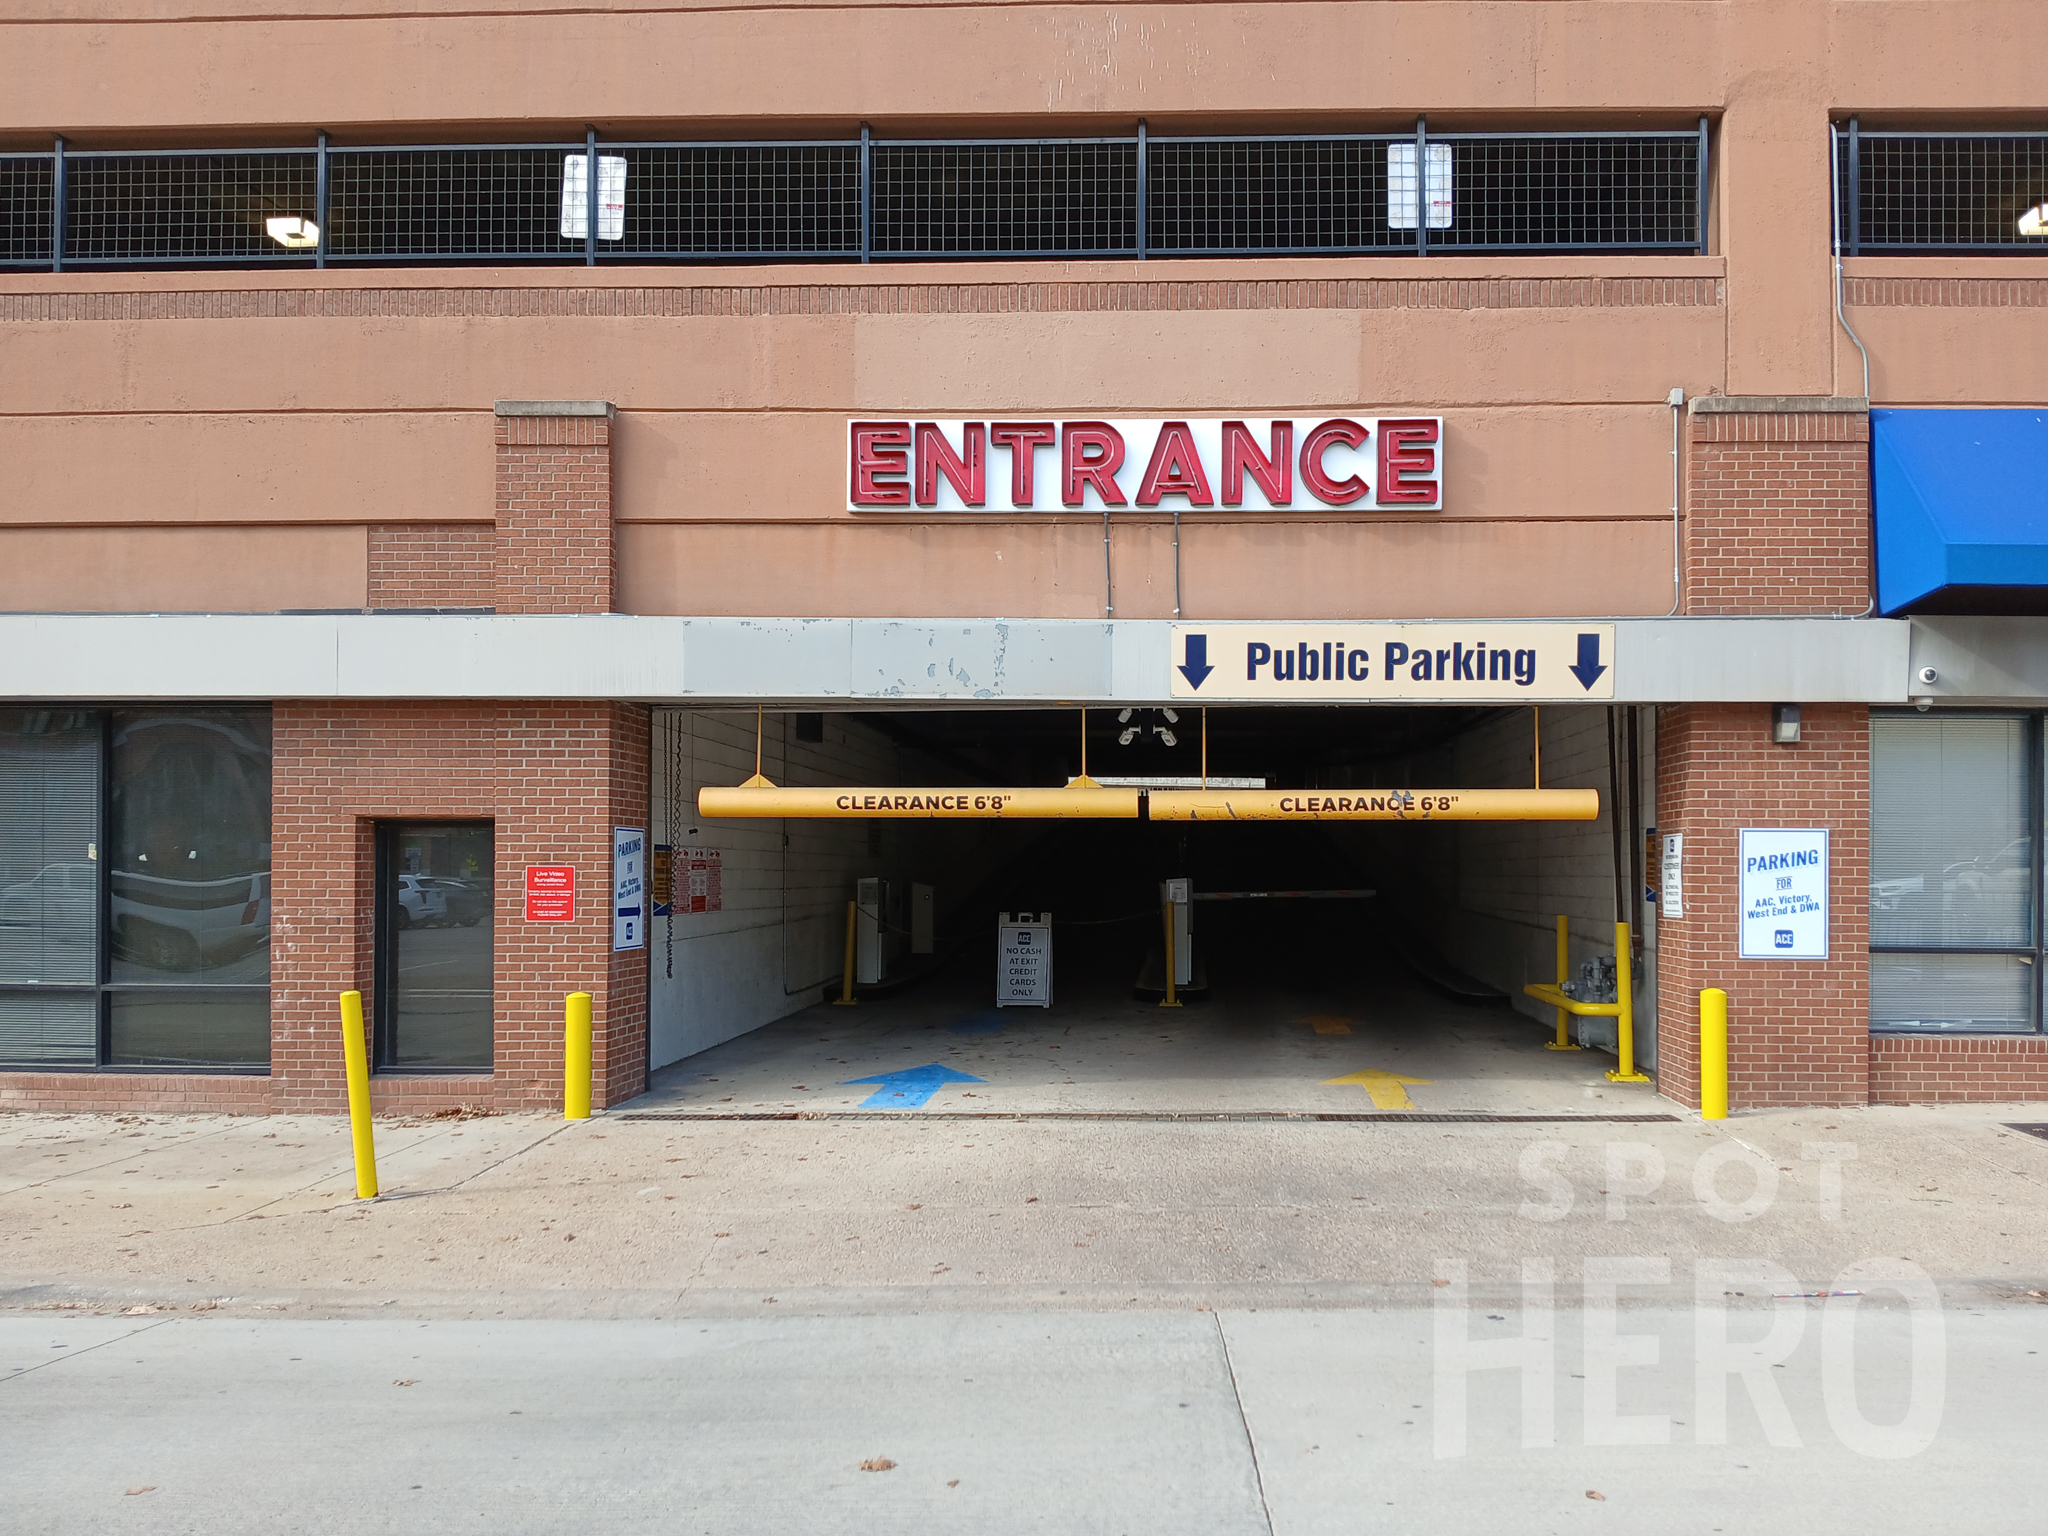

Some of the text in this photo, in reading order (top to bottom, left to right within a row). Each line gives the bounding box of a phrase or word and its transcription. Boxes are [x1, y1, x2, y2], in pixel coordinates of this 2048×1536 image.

[850, 419, 1438, 506] ENTRANCE
[1247, 641, 1536, 687] Public Parking
[836, 795, 1012, 811] CLEARANCE 6'8"
[1280, 796, 1459, 812] CLEARANCE 6'8"
[618, 838, 641, 857] PARKING
[1747, 849, 1818, 873] PARKING
[1776, 878, 1792, 889] FOR
[1747, 902, 1820, 919] West End & DWA
[1775, 933, 1793, 945] ACE
[1006, 947, 1042, 955] NO CASH
[1009, 968, 1038, 976] CREDIT
[1010, 978, 1037, 986] CARDS
